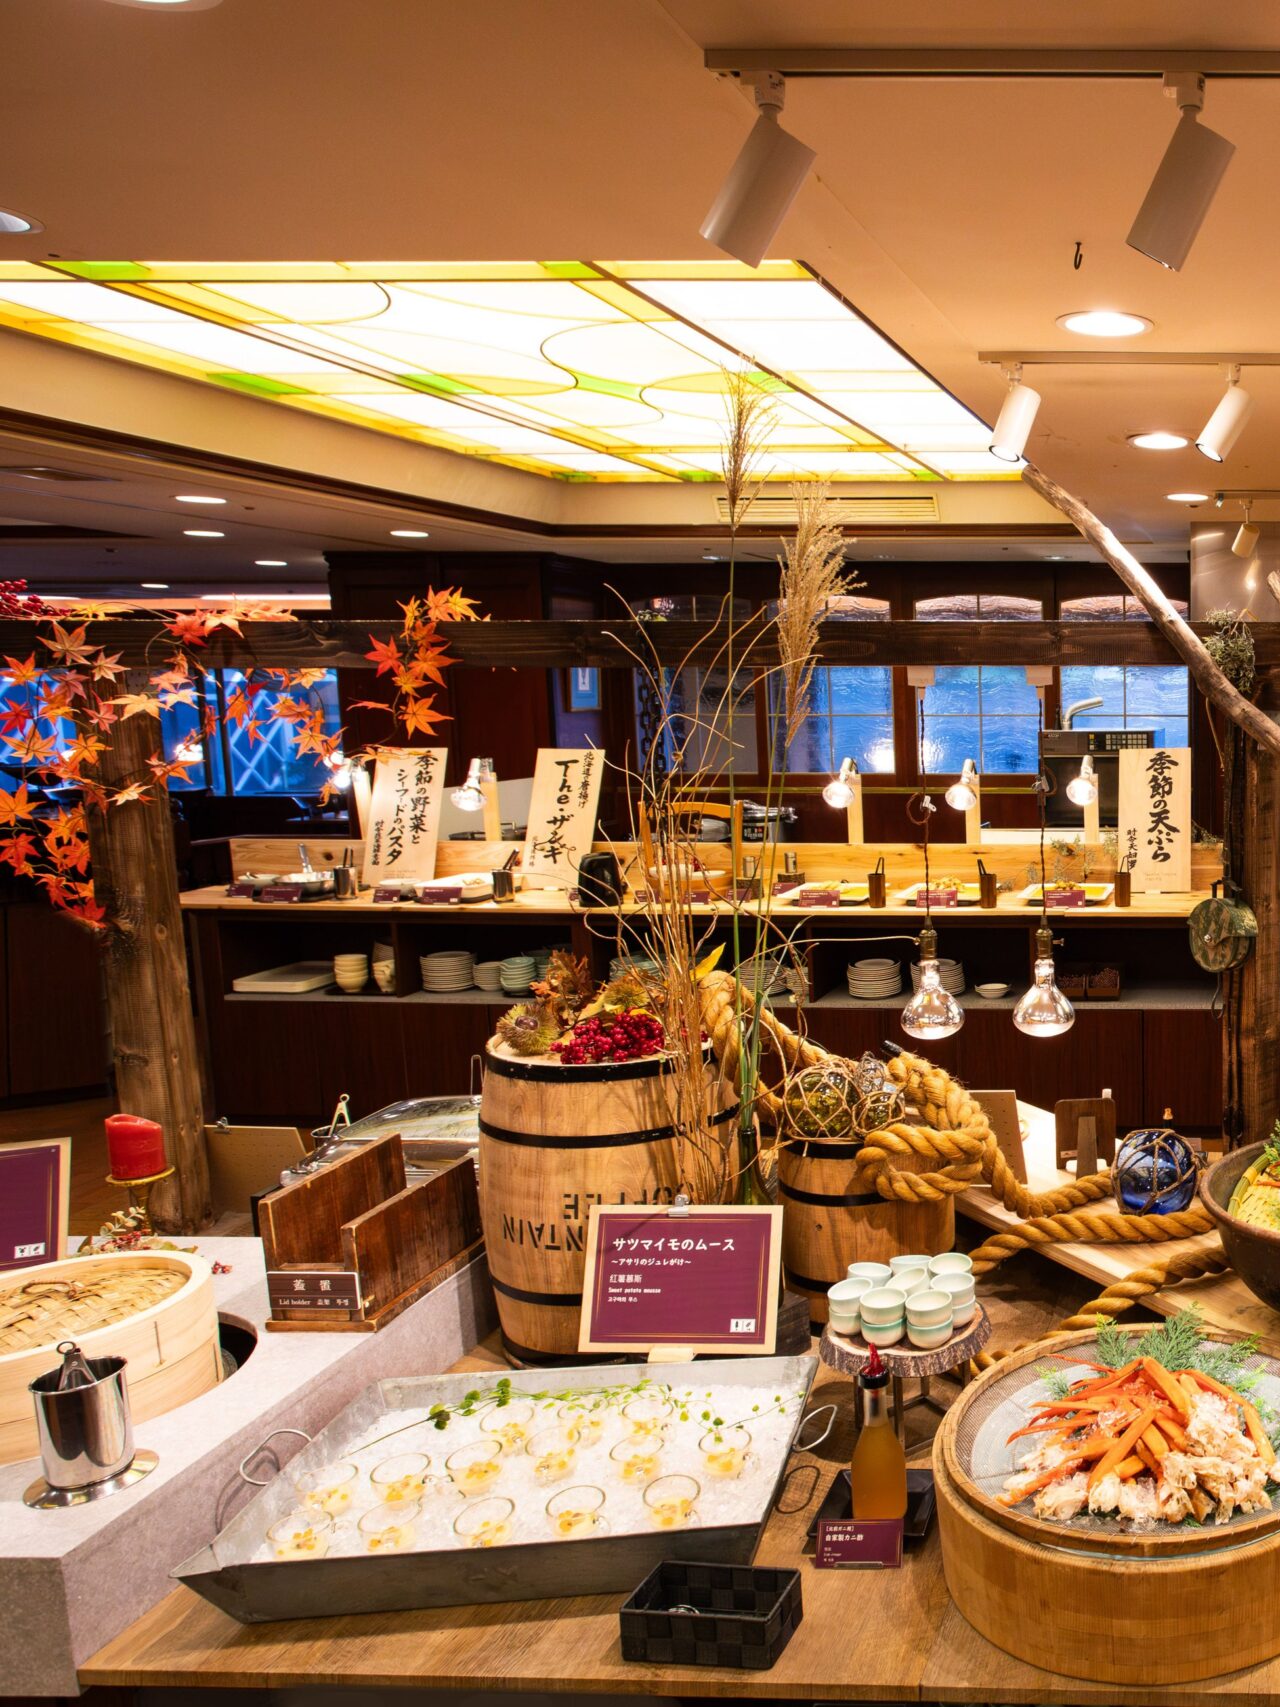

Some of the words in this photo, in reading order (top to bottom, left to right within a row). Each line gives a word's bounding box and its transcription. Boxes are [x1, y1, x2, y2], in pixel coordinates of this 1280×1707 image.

[409, 750, 439, 845] 季節の野菜と
[1146, 750, 1181, 863] 季節の天ぷら
[612, 1237, 735, 1251] サツマイモのムース
